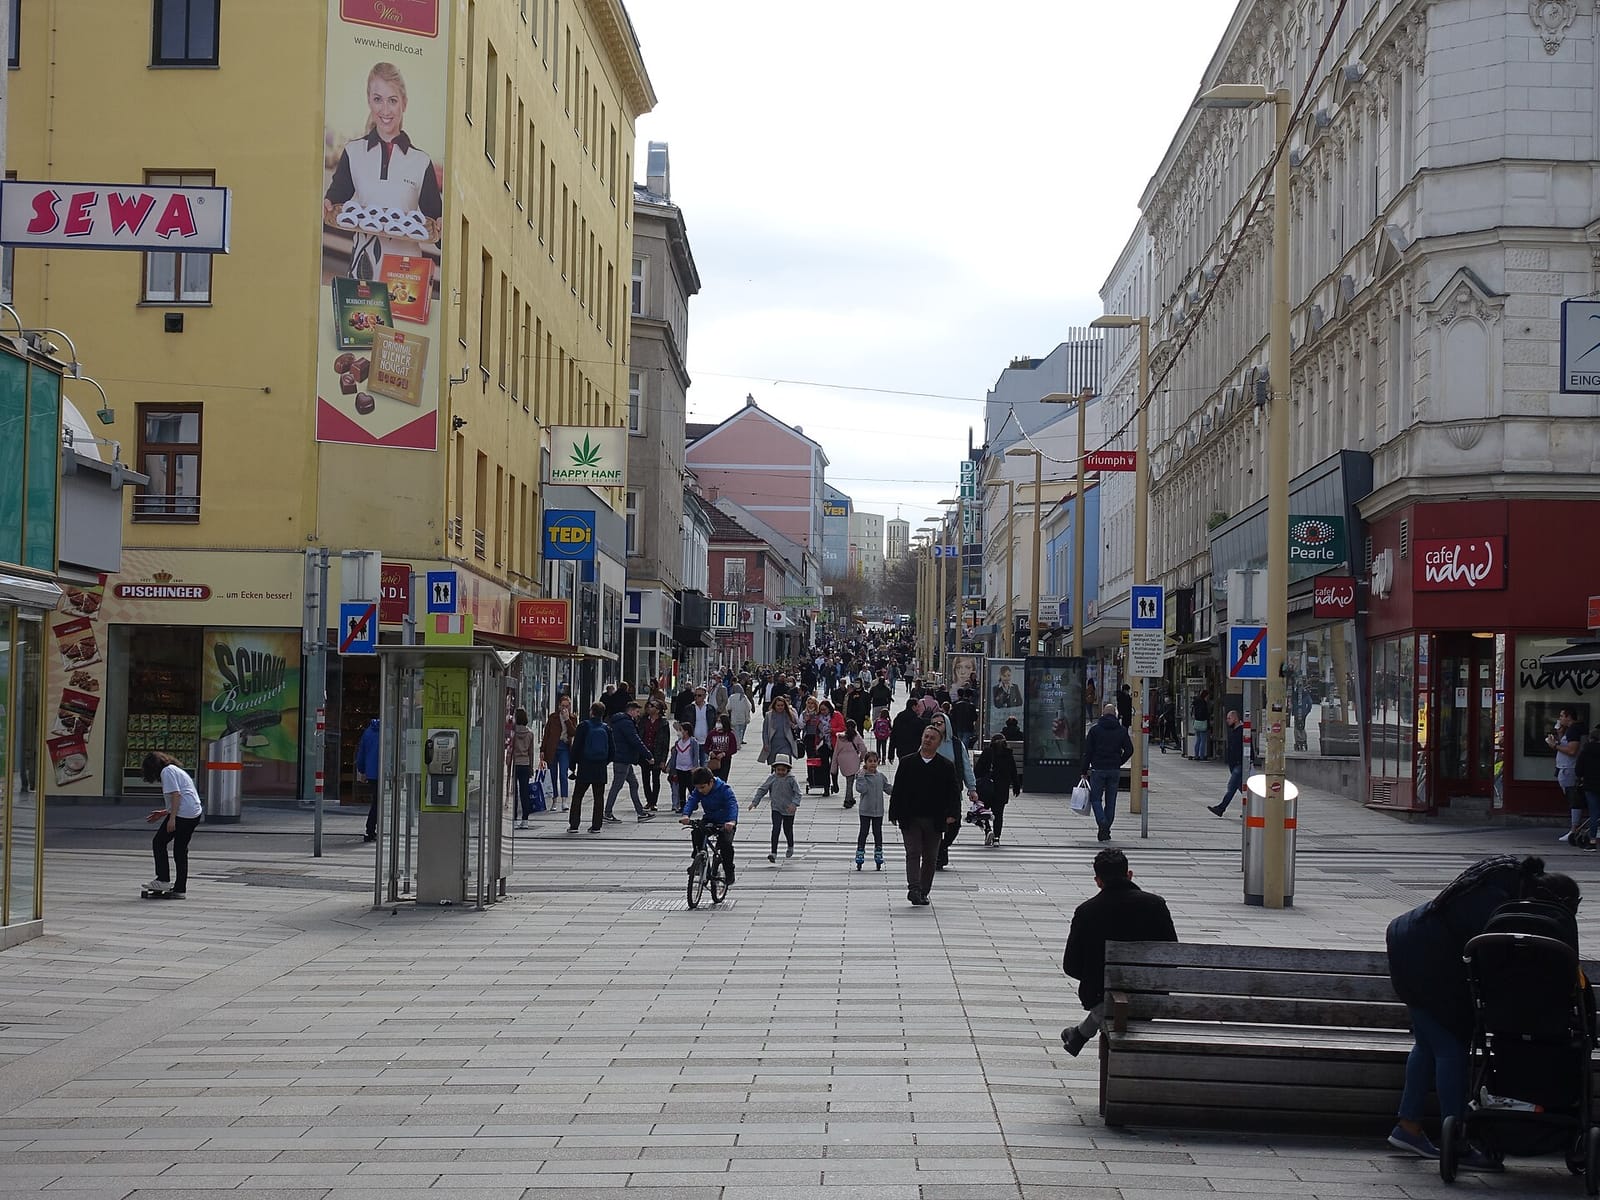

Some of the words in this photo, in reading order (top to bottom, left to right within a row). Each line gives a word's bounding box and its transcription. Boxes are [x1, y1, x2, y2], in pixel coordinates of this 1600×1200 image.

[354, 36, 423, 56] www.heindl.co.at
[552, 469, 589, 478] HAPPY
[591, 470, 622, 479] HANF
[548, 526, 592, 543] TEDi
[1290, 546, 1335, 559] Pearle
[1425, 546, 1453, 564] cafe
[121, 586, 203, 598] PISCHINGER
[226, 591, 239, 599] um
[241, 590, 264, 600] Ecken
[266, 591, 293, 600] besser!
[1315, 587, 1331, 596] cafe
[520, 616, 563, 625] HEINDL
[211, 684, 286, 713] Bananen
